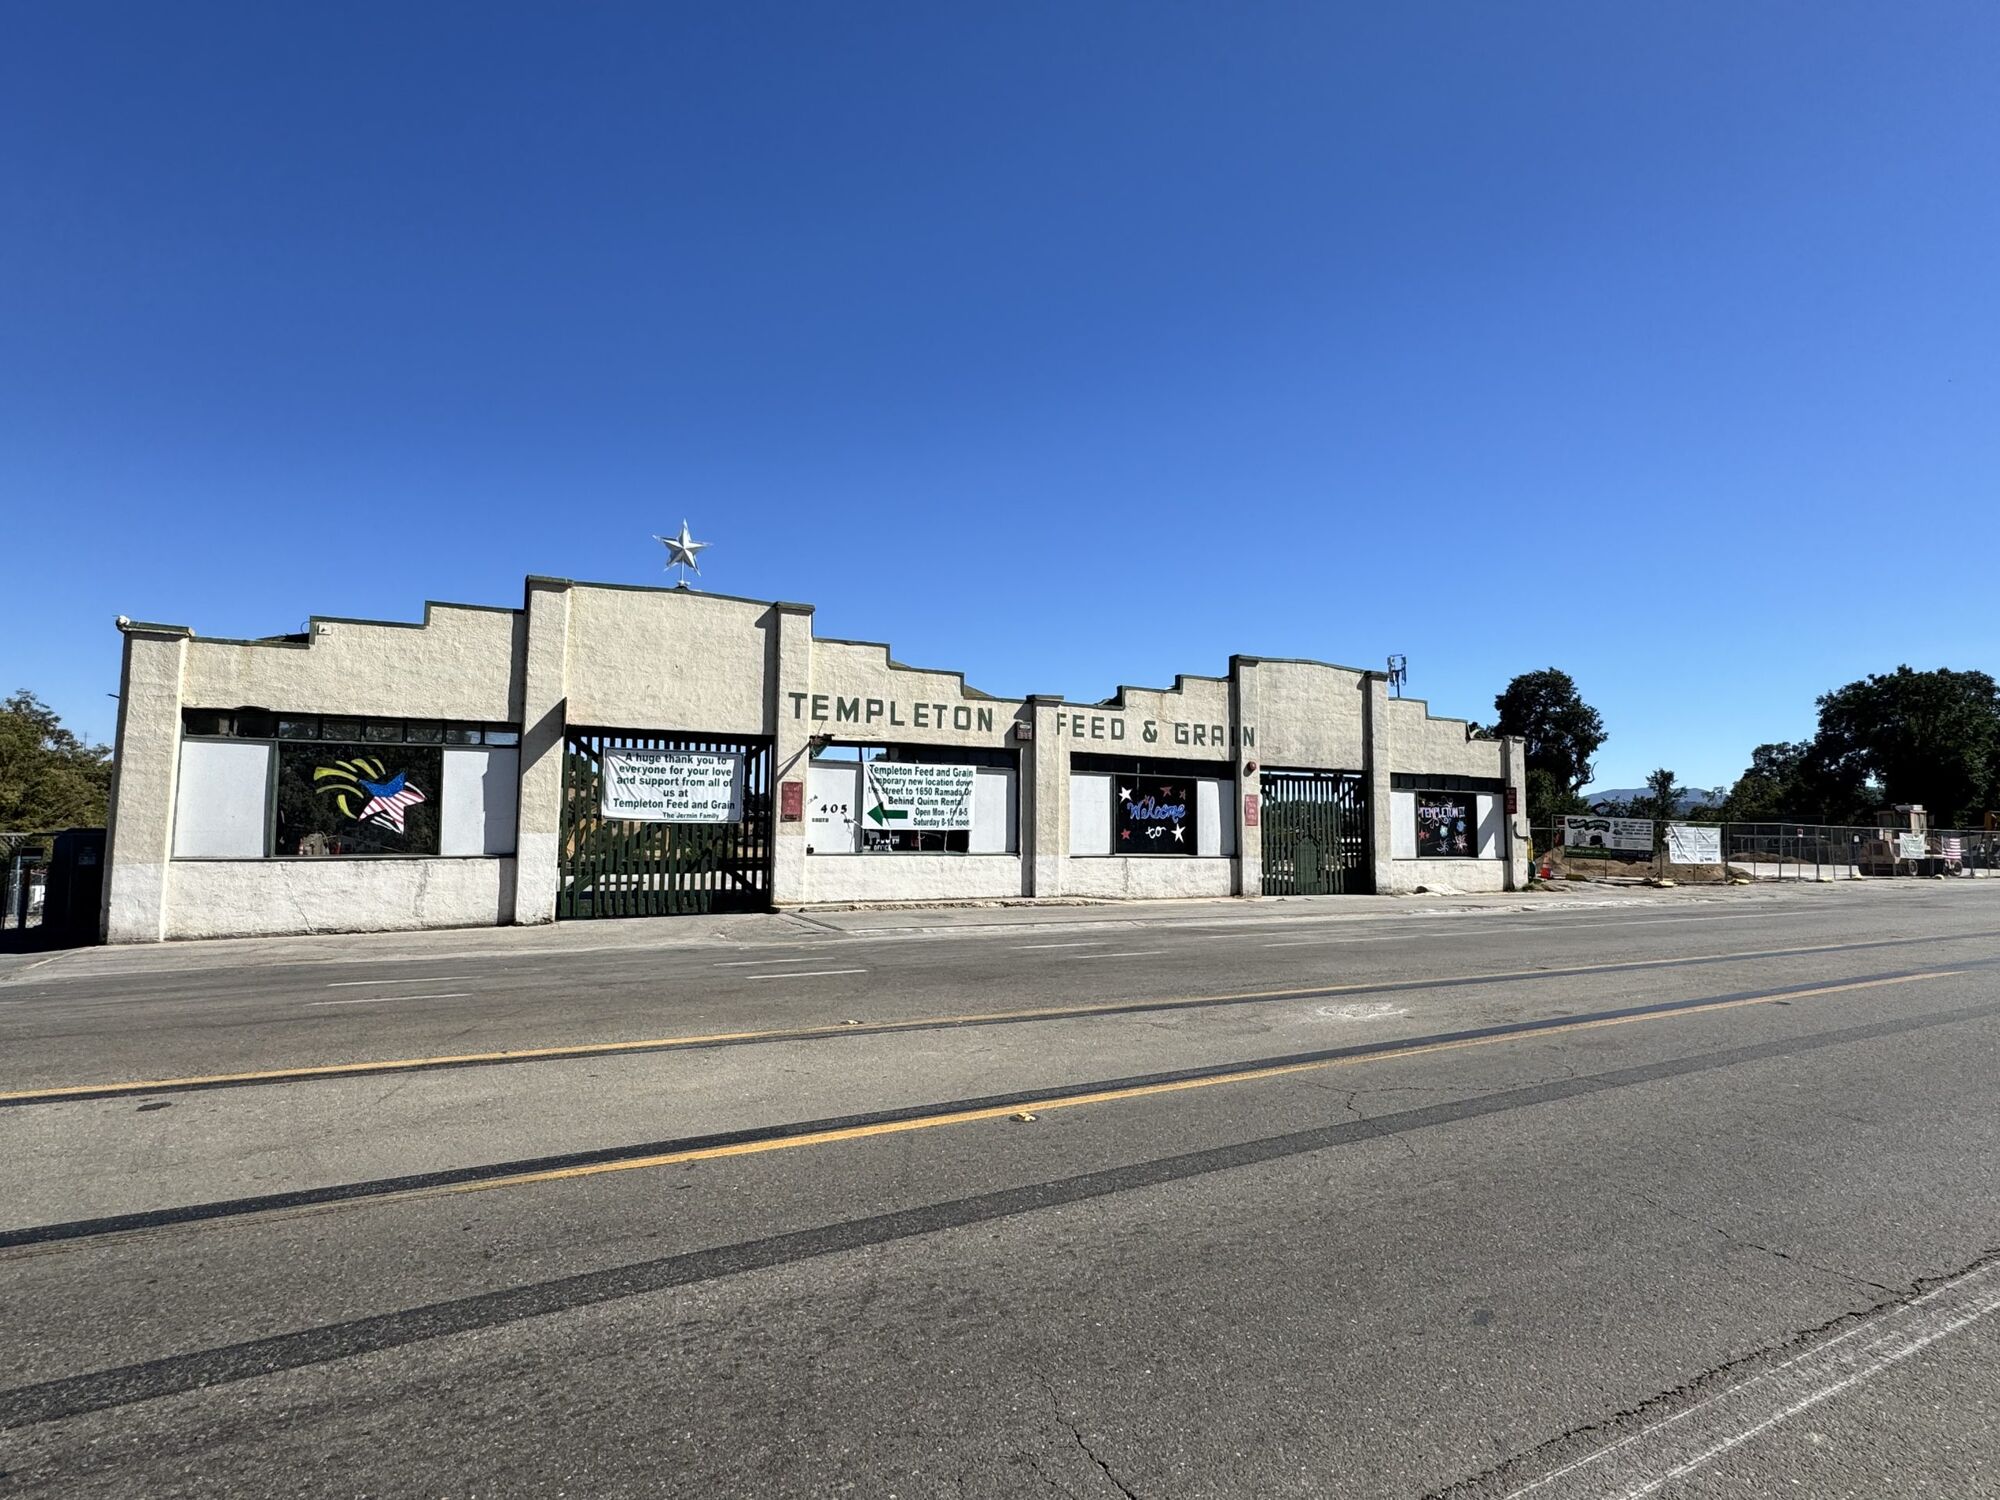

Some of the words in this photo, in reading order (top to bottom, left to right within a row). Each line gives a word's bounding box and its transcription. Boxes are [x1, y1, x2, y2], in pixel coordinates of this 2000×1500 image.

[789, 692, 993, 732] TEMPLETON
[1057, 712, 1125, 741] FEED
[1142, 720, 1158, 743] &
[1174, 722, 1255, 748] GRAIN
[625, 752, 632, 761] A
[636, 753, 661, 764] huge
[664, 754, 693, 764] thank
[697, 756, 714, 766] you
[717, 756, 727, 765] to
[619, 764, 666, 776] everyone
[670, 766, 683, 774] for
[687, 768, 709, 778] your
[712, 768, 732, 776] love
[869, 764, 912, 776] Templeton
[914, 766, 934, 776] Feed
[936, 768, 950, 776] and
[953, 768, 973, 778] Grain
[616, 776, 636, 784] and
[640, 778, 679, 787] support
[682, 778, 705, 787] from
[708, 778, 719, 787] all
[723, 778, 733, 787] of
[925, 778, 954, 786] location
[906, 787, 913, 795] to
[935, 788, 962, 796] Ramada
[613, 798, 663, 810] Templeton
[666, 800, 688, 809] Feed
[691, 800, 708, 809] and
[711, 800, 735, 810] Grain
[888, 796, 914, 805] Behind
[917, 798, 938, 806] Quinn
[820, 804, 847, 814] 405
[915, 808, 930, 817] Open
[1127, 796, 1186, 823] Welcome
[700, 812, 720, 820] Family
[913, 818, 940, 828] Saturday
[1145, 825, 1166, 839] to
